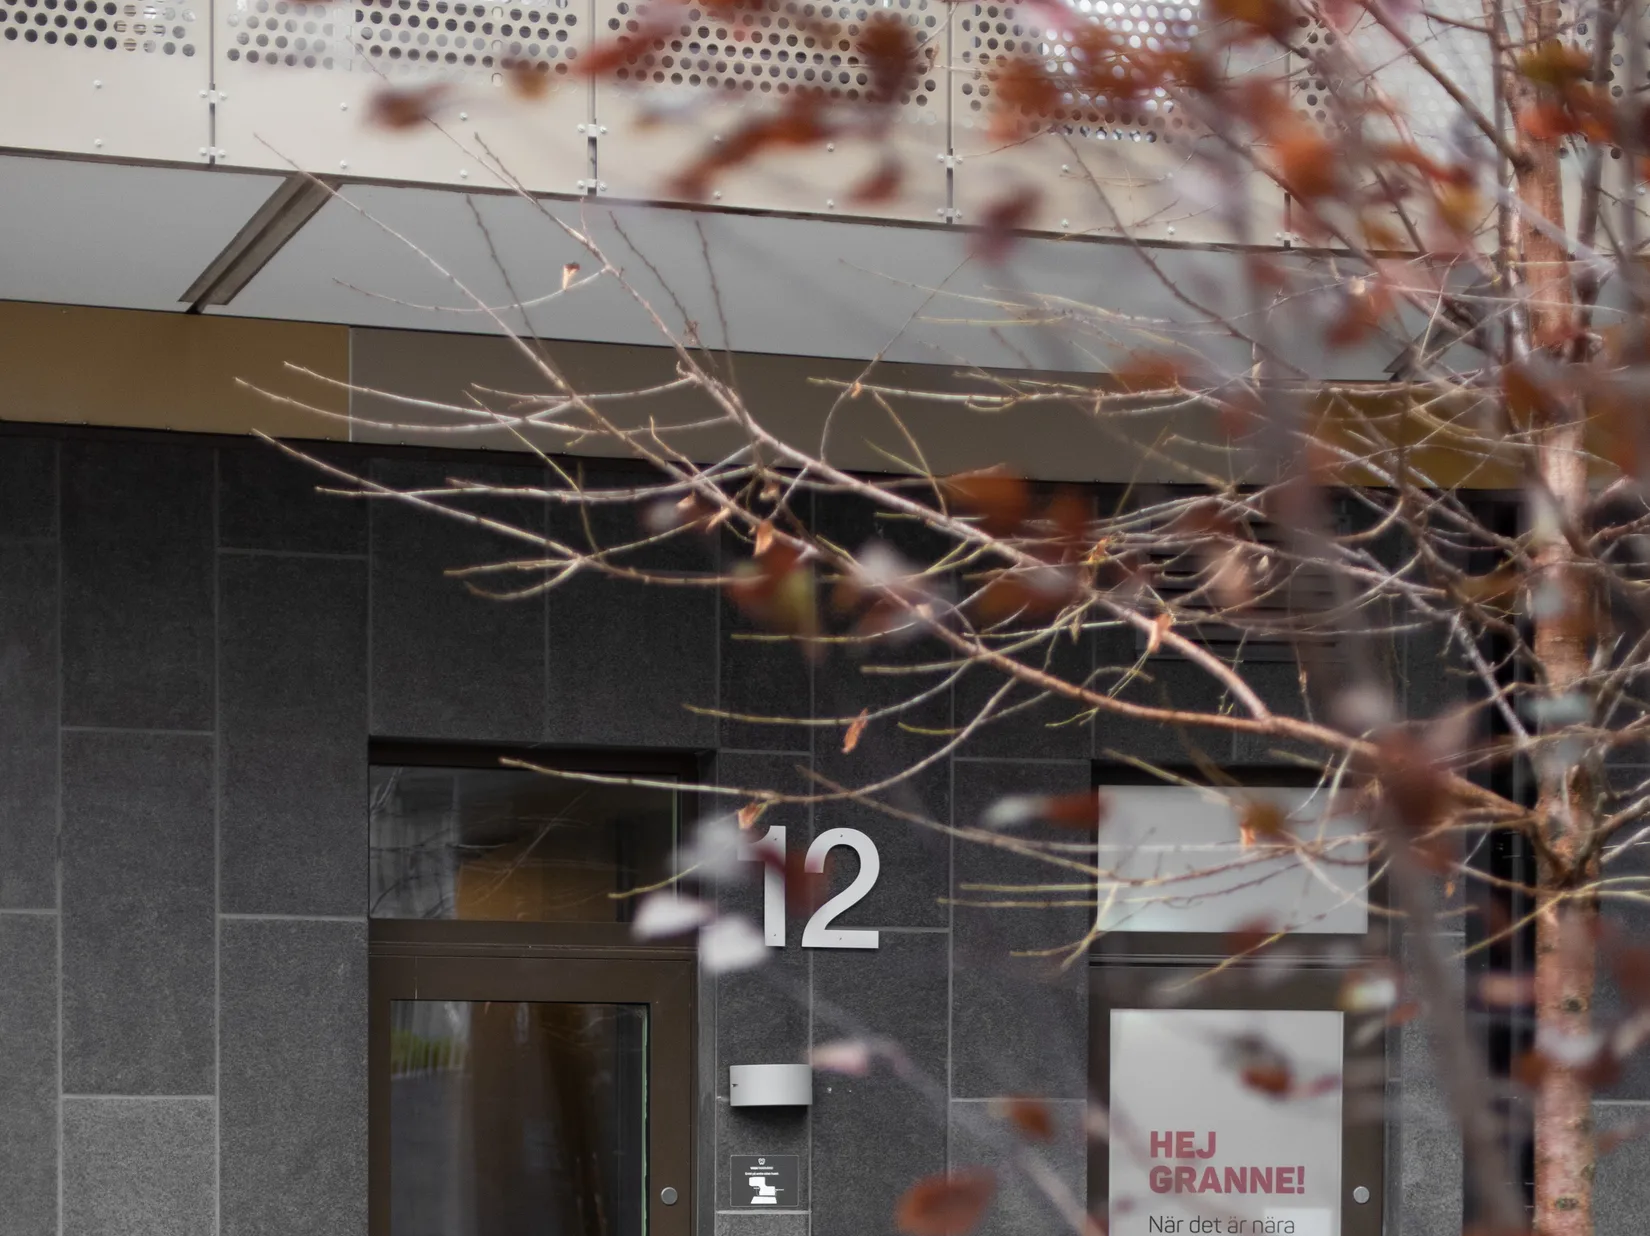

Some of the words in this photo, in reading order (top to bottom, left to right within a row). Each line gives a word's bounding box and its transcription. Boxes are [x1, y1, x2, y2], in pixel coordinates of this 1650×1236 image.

[737, 825, 880, 948] 12
[1150, 1131, 1216, 1159] HEJ
[1149, 1165, 1305, 1194] GRANNE!
[1148, 1215, 1184, 1234] När
[1189, 1215, 1222, 1234] det
[1226, 1215, 1247, 1234] är
[1252, 1215, 1295, 1234] nära
